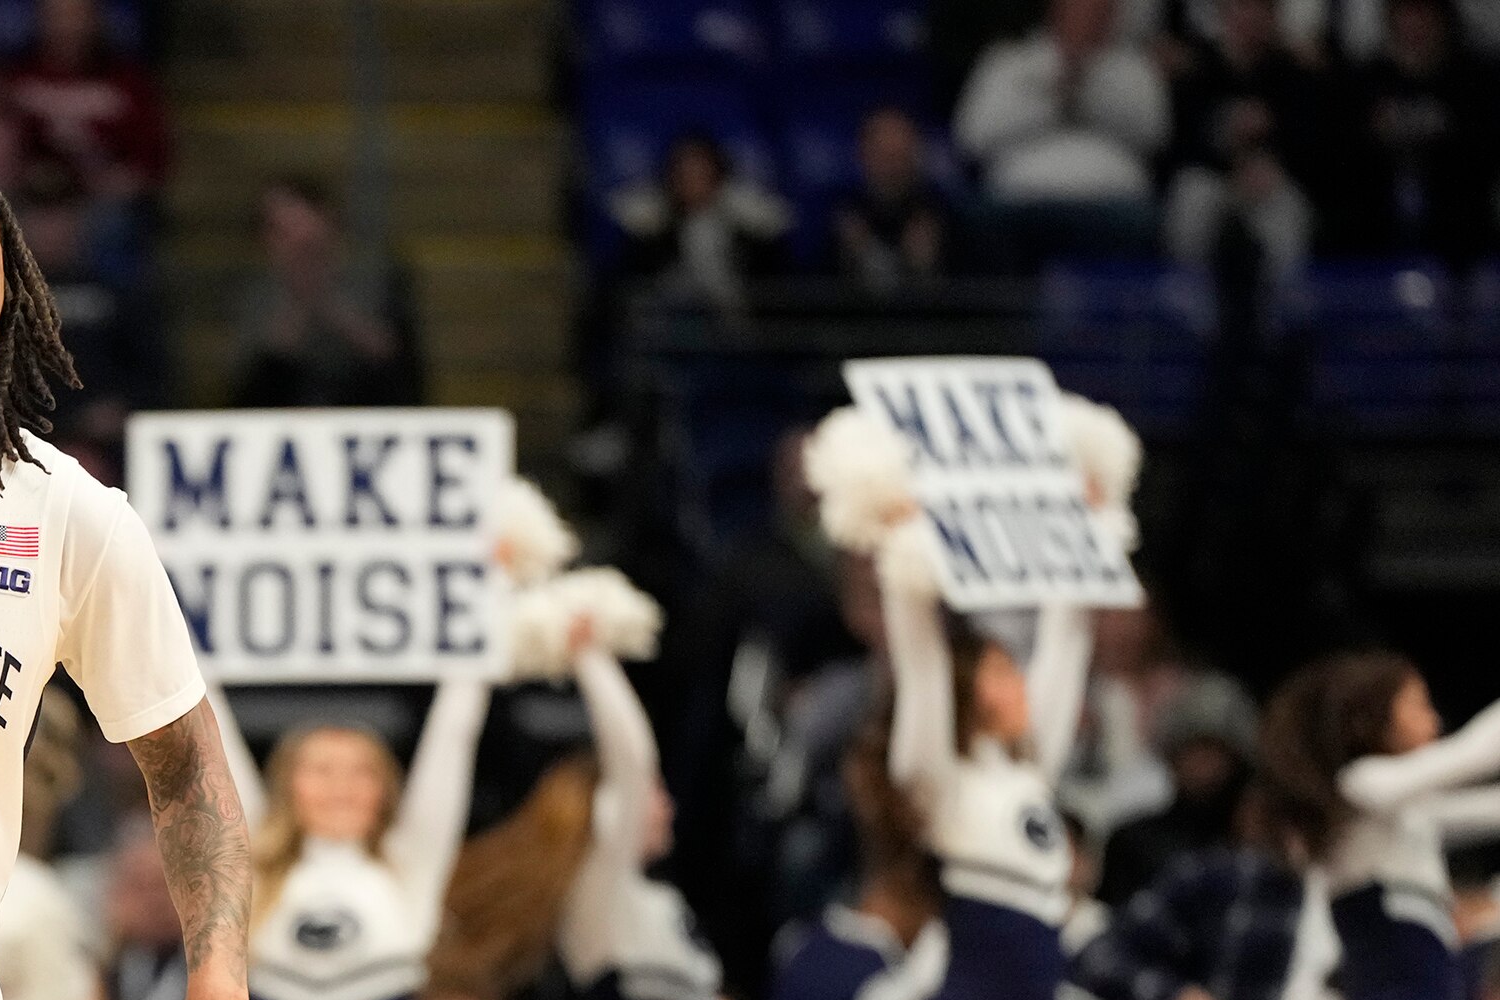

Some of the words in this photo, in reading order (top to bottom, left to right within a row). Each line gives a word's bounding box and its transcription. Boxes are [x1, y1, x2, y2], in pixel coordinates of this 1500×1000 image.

[873, 381, 1068, 467] MAKE
[163, 434, 480, 531] MAKE
[163, 560, 487, 657] NOISE
